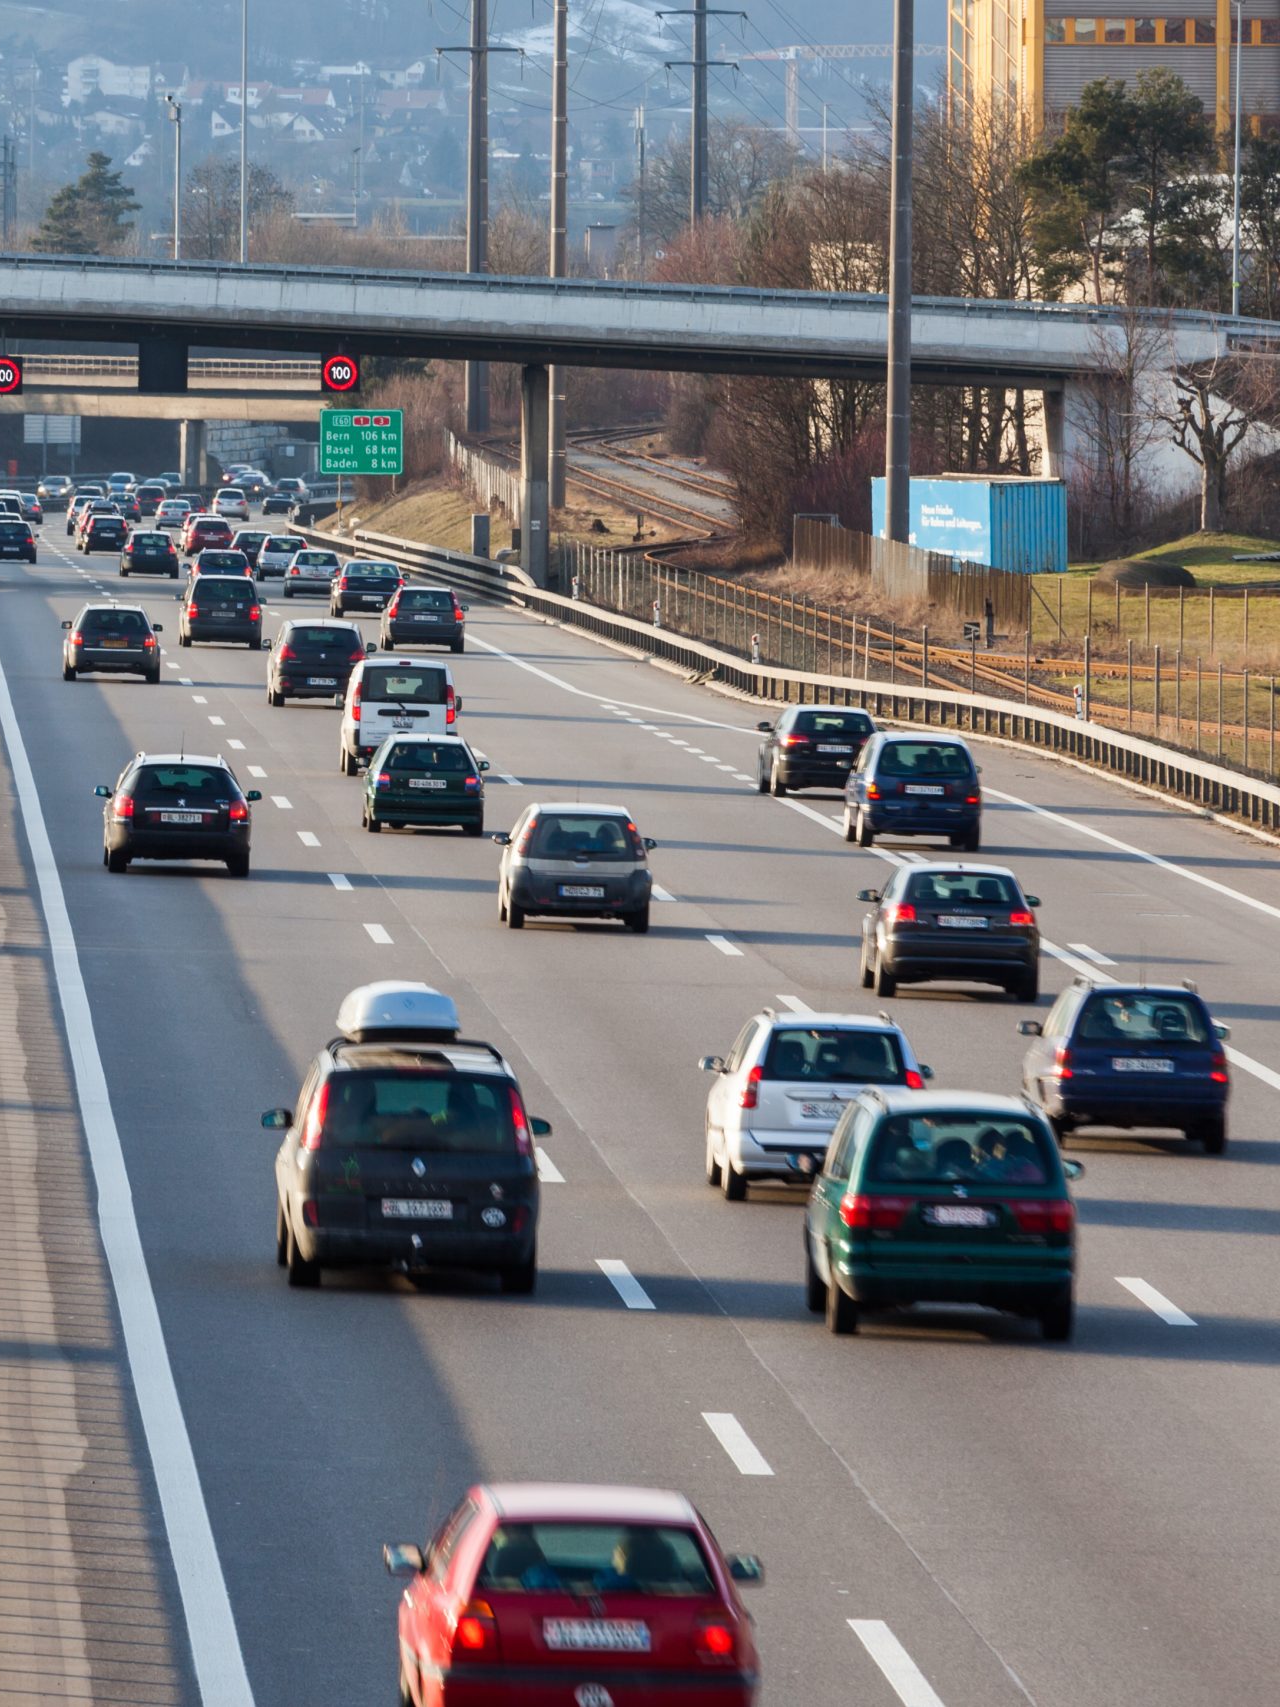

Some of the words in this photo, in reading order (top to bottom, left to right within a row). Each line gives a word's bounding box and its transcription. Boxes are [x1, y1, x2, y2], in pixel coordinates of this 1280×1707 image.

[331, 366, 351, 379] 100
[335, 416, 349, 424] E60
[360, 417, 364, 425] 1
[379, 417, 384, 425] 3
[326, 431, 350, 441] Bern
[361, 431, 378, 441] 106
[381, 431, 397, 441] km
[326, 444, 354, 455] Basel
[365, 445, 378, 455] 68
[381, 445, 397, 455] km
[326, 458, 358, 468] Baden
[371, 459, 378, 468] 8
[381, 458, 397, 468] km
